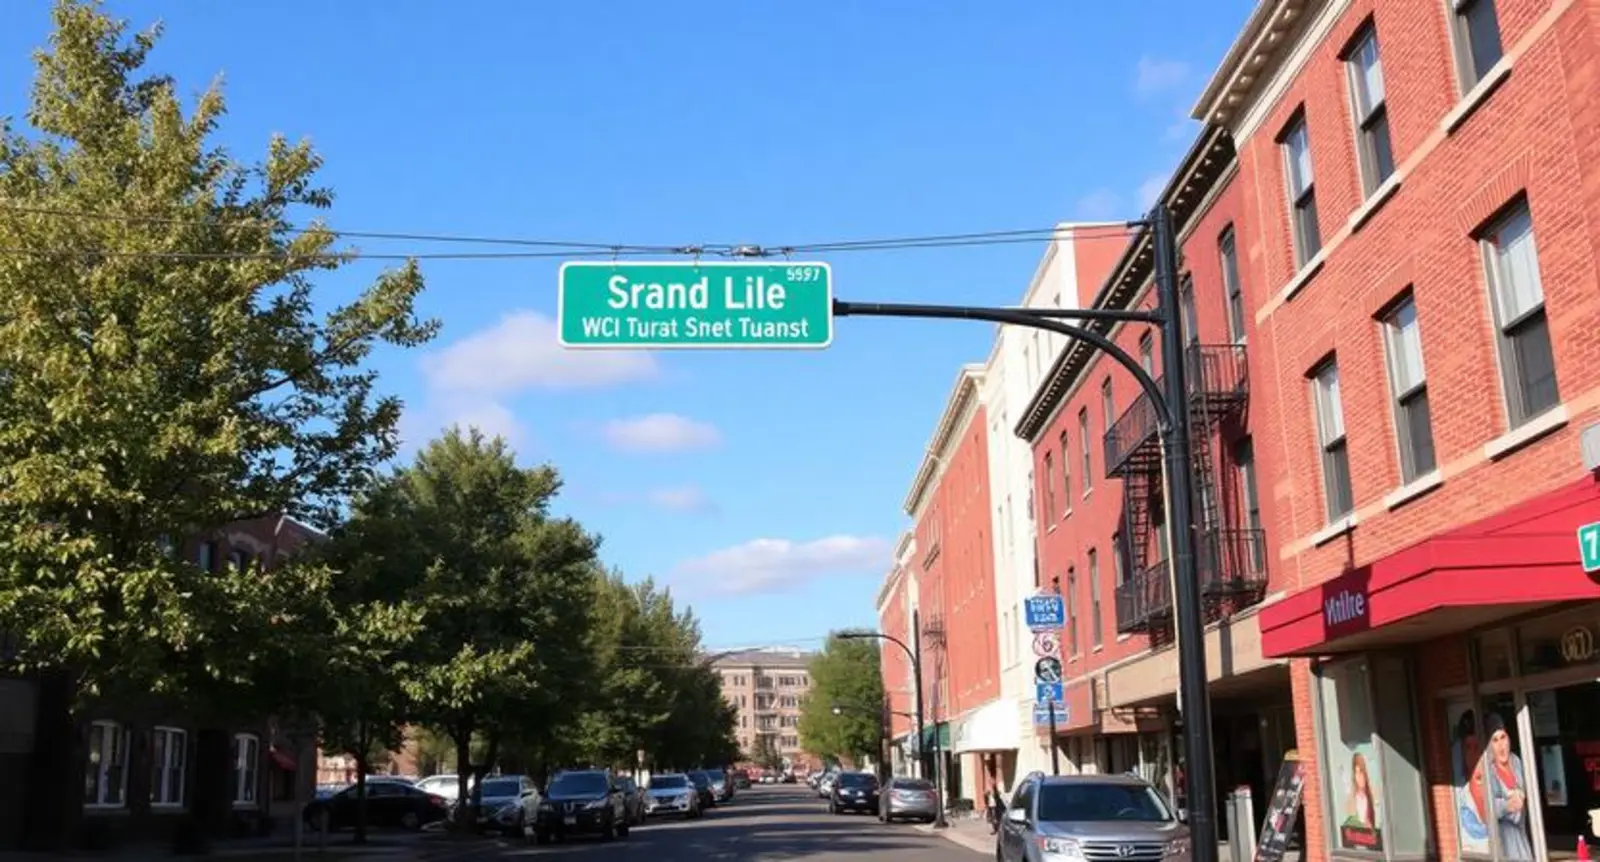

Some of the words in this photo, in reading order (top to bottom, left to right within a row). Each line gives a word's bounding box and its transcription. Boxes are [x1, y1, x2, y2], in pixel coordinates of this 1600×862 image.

[608, 274, 709, 309] Srand
[724, 276, 787, 309] Lile
[626, 316, 679, 337] Turat
[685, 316, 733, 338] Snet
[738, 316, 809, 338] Tuanst
